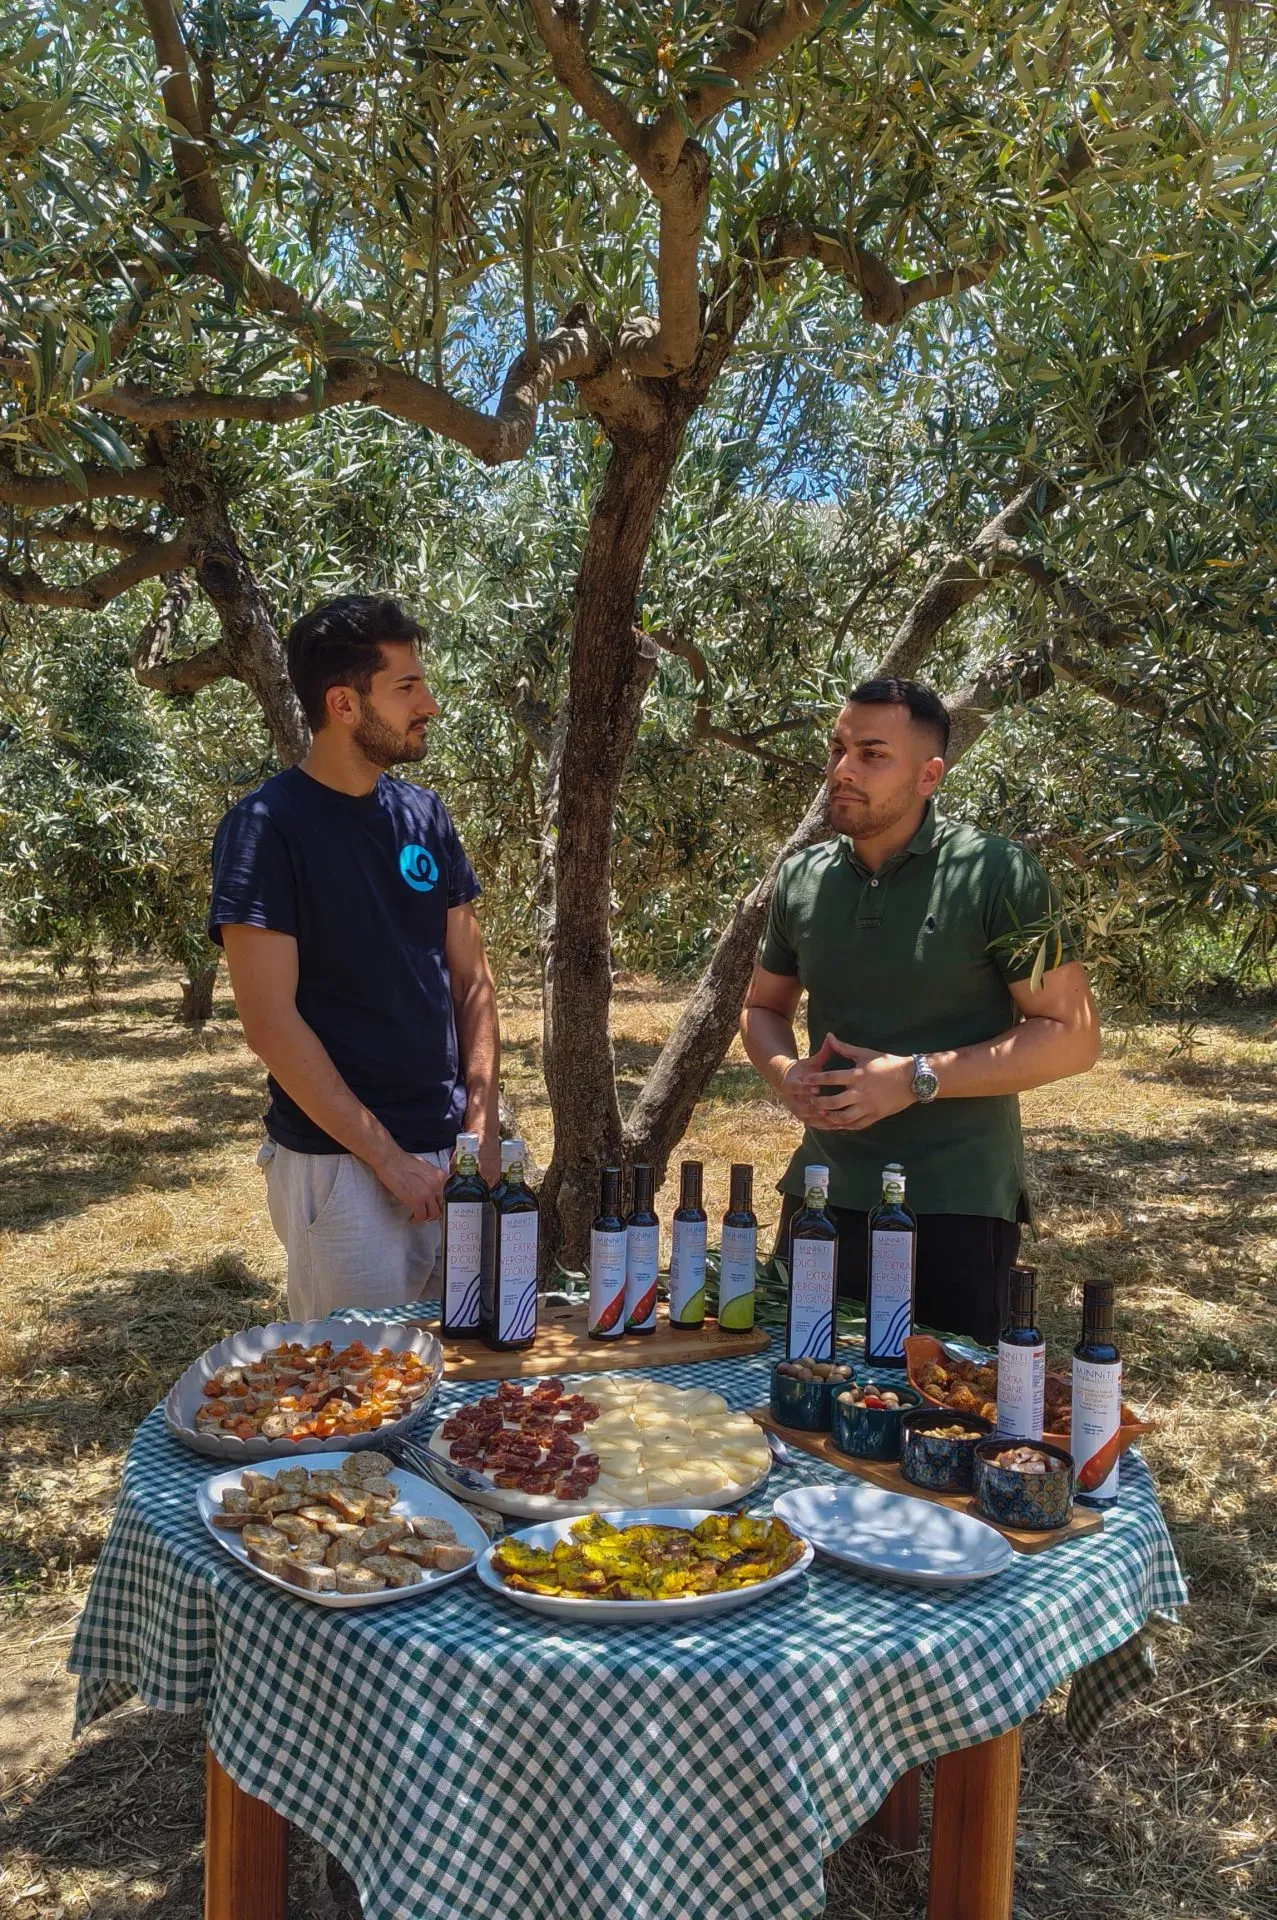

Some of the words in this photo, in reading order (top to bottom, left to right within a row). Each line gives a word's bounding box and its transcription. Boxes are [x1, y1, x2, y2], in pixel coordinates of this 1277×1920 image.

[460, 1232, 480, 1241] EXTR
[447, 1243, 480, 1253] VERGIN
[450, 1255, 480, 1264] D'OLIV
[885, 1261, 911, 1271] EXTRA
[806, 1271, 832, 1280] EXTRA
[872, 1272, 911, 1282] VERGINE
[792, 1281, 832, 1292] VERGINE
